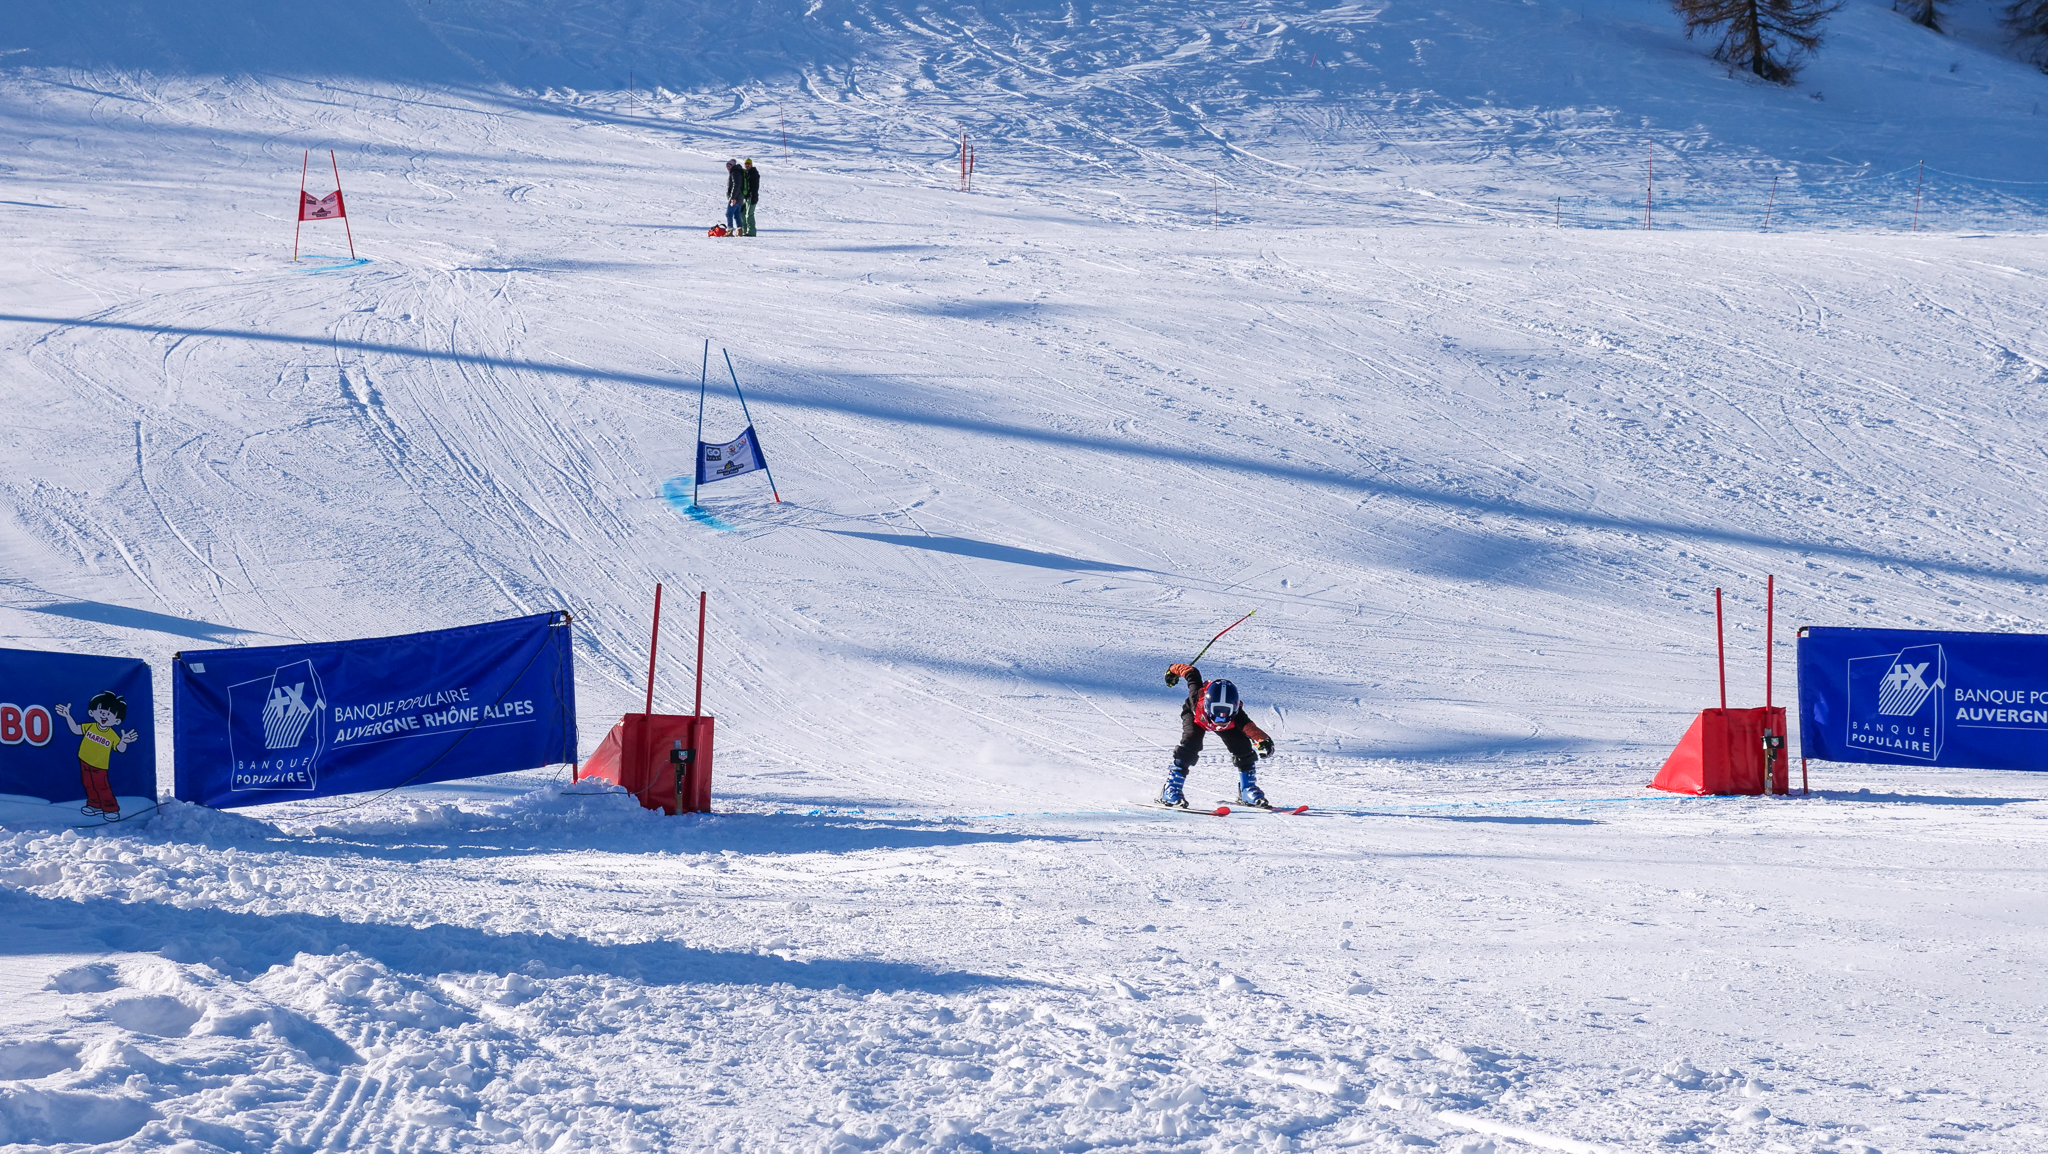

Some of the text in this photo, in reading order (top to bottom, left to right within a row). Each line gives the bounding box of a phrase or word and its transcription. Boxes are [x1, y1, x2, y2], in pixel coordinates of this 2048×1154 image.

[334, 687, 470, 722] BANQUE POPULAIRE
[1955, 688, 2025, 705] BANQUE
[333, 700, 534, 743] AUVERGNE RHÔNE ALPES
[1955, 707, 2048, 724] AUVERGN
[0, 704, 51, 745] BO
[1852, 721, 1930, 737] BANQUE
[86, 731, 111, 747] HARIBO
[1852, 733, 1930, 752] POPULAIRE
[238, 757, 309, 771] BANQUE
[236, 771, 307, 784] POPULAIRE
